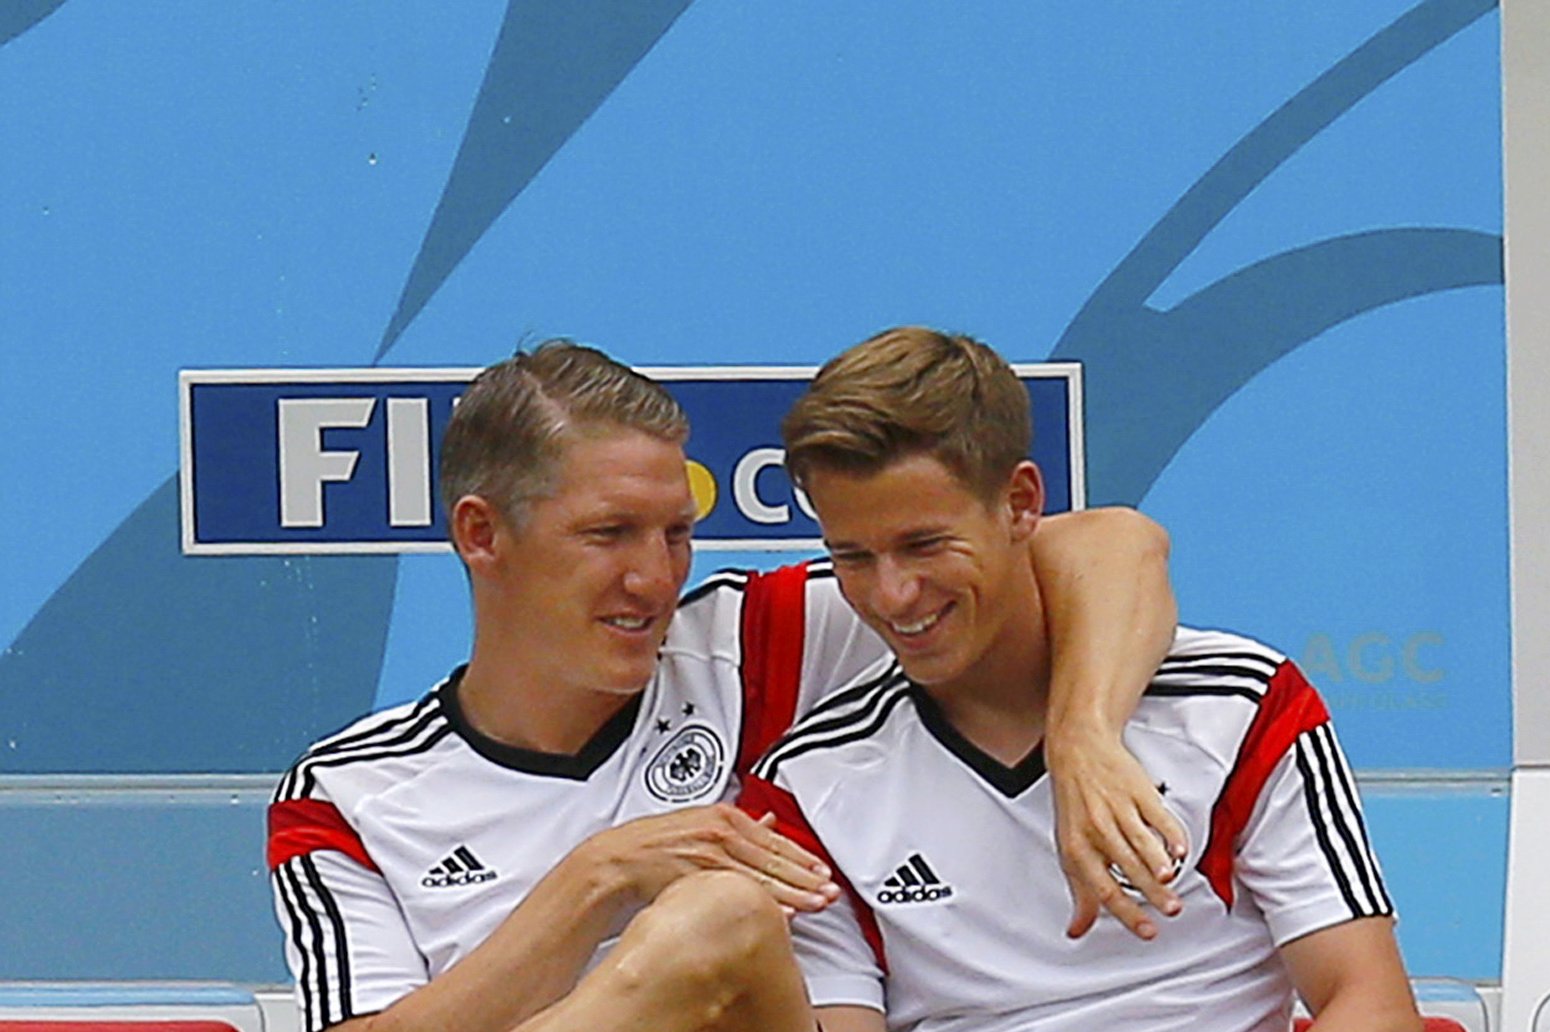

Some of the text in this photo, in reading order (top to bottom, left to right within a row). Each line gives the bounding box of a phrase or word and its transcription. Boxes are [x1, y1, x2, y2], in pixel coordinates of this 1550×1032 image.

[1300, 629, 1447, 684] AGC
[421, 869, 499, 888] adidas
[877, 885, 953, 904] adidas
